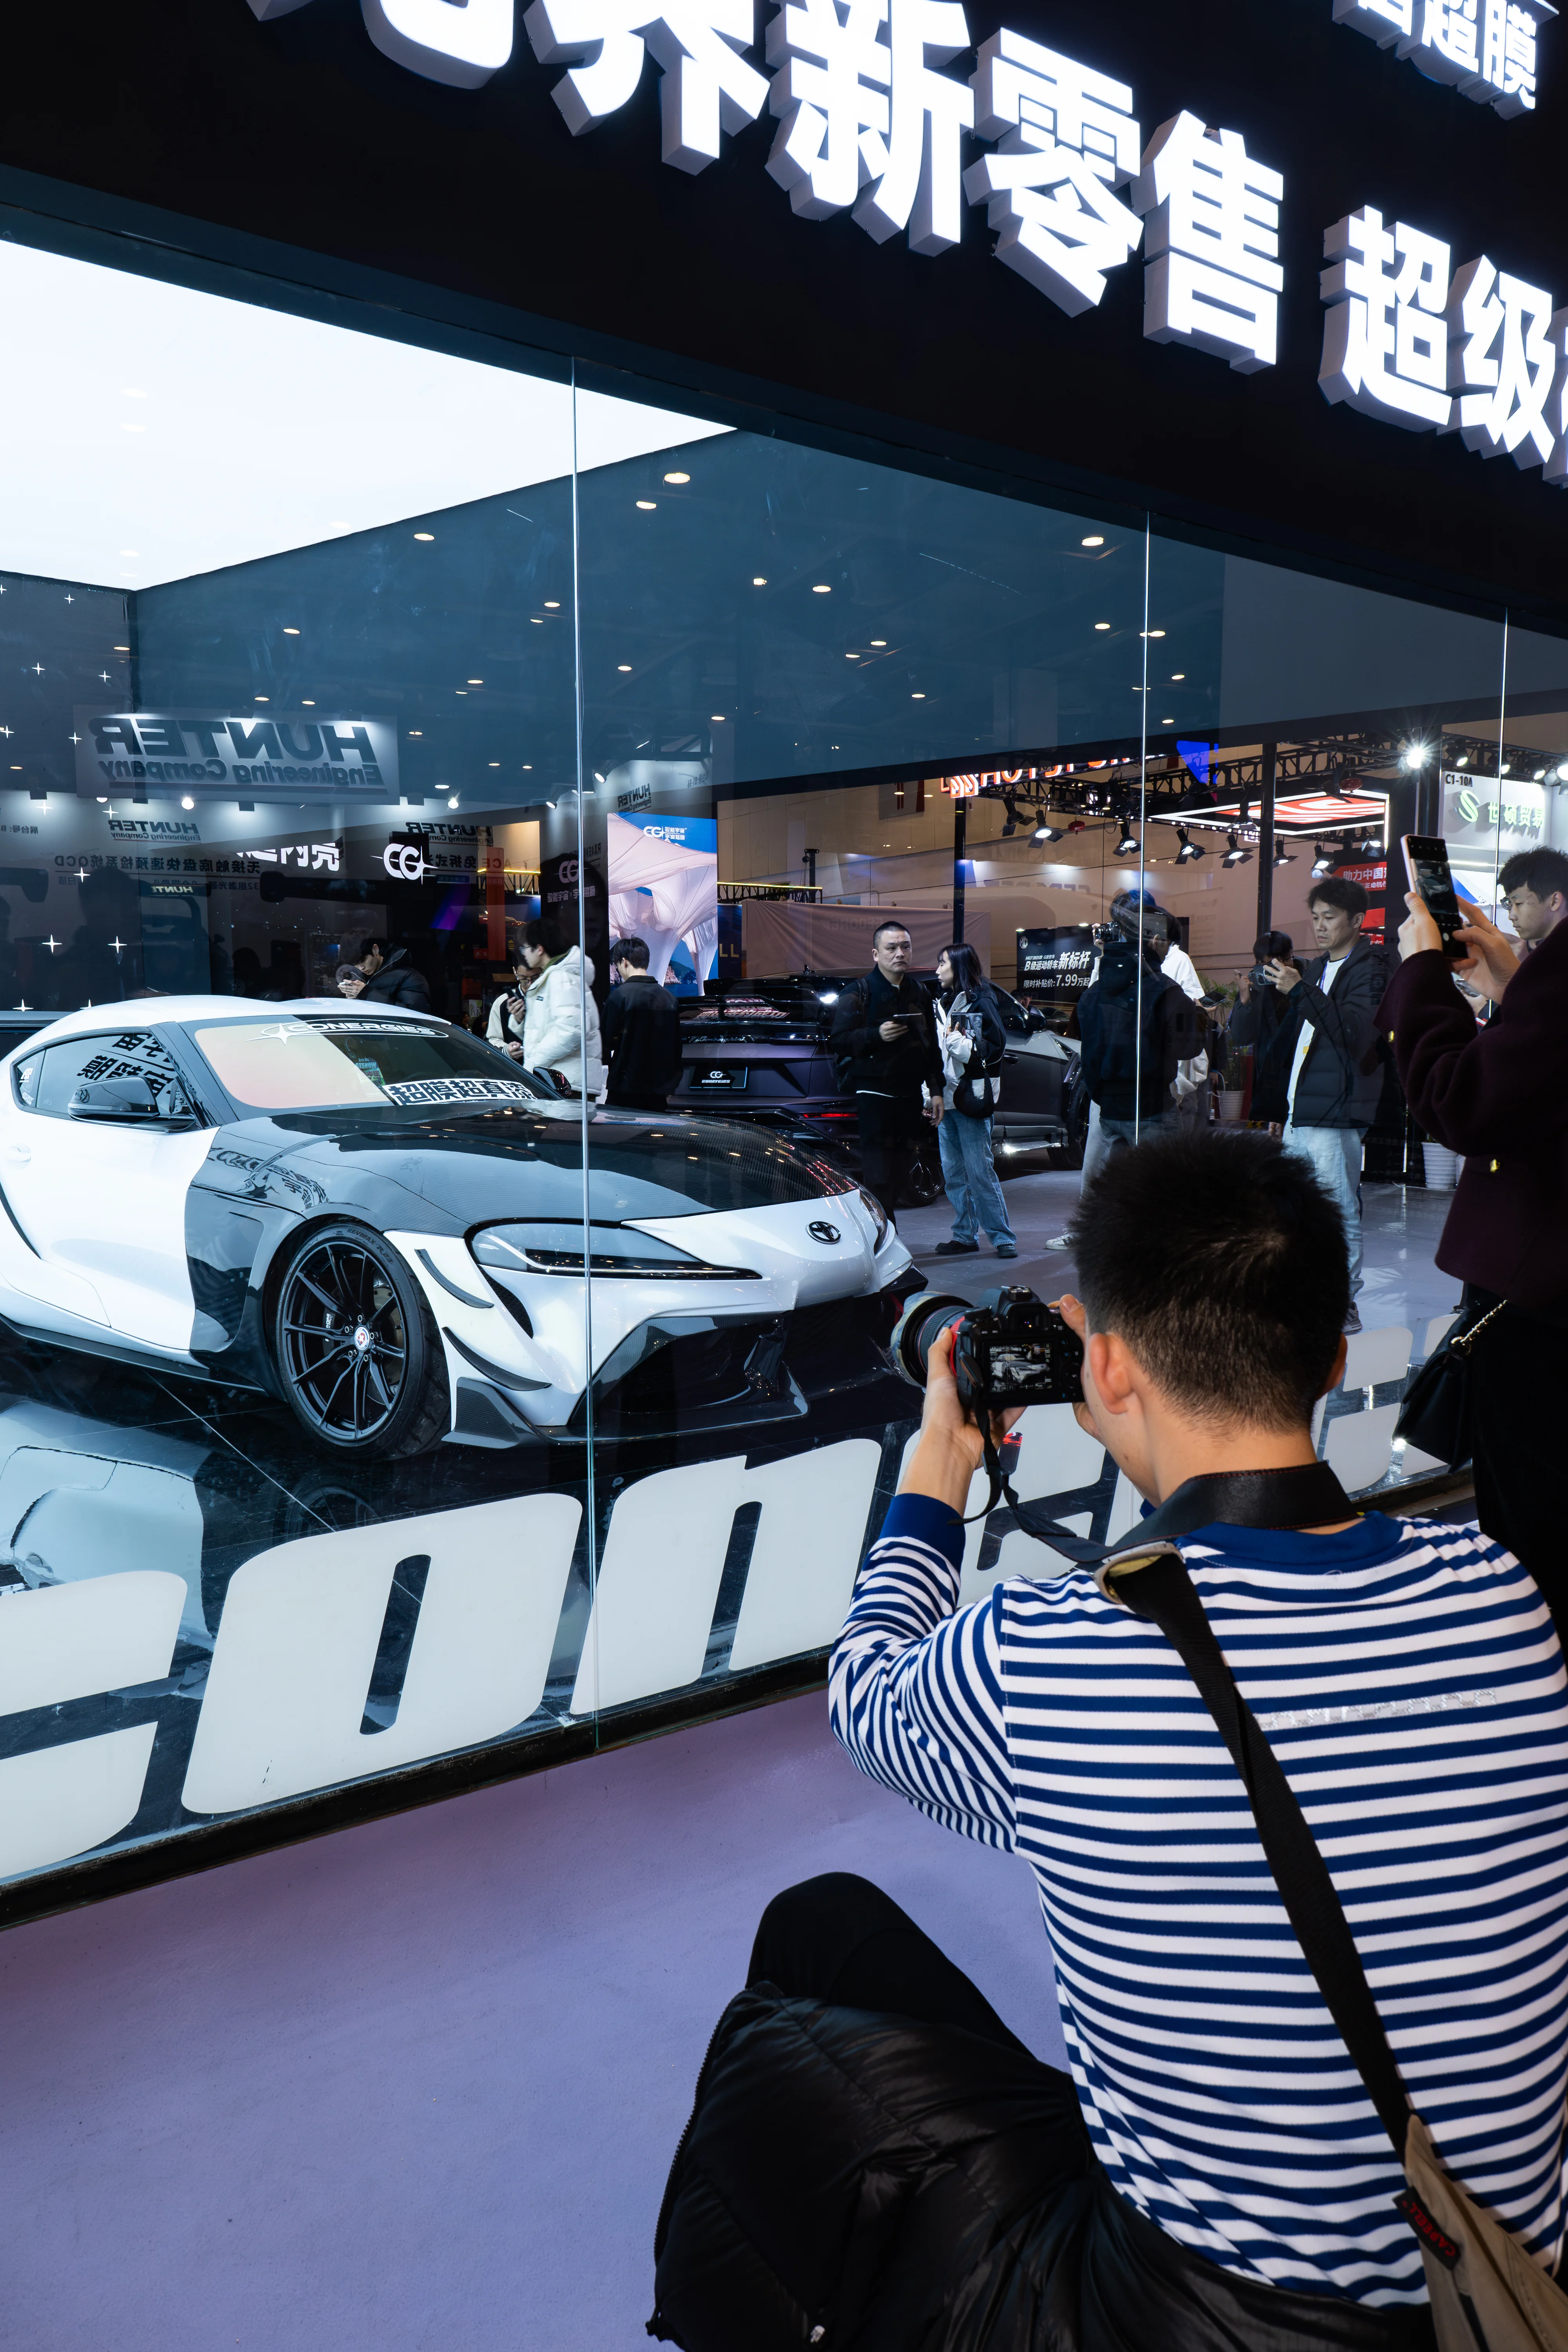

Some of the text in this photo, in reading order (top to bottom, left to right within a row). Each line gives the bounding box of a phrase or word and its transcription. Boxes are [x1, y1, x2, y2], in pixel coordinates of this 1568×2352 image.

[380, 0, 1568, 474] 界新零售 超级
[1445, 773, 1473, 787] C1-10A
[287, 1022, 436, 1036] CONERGIES
